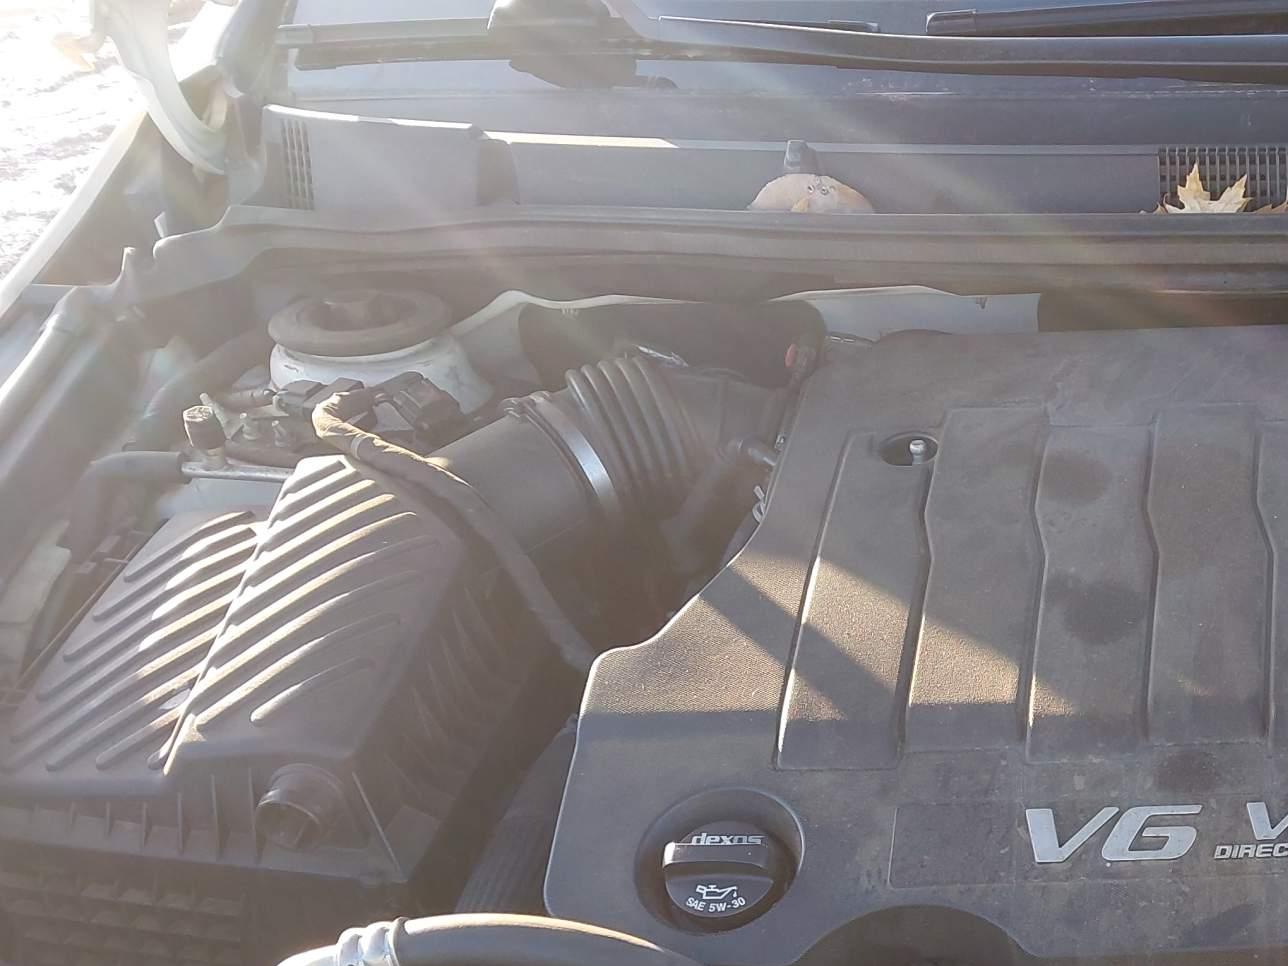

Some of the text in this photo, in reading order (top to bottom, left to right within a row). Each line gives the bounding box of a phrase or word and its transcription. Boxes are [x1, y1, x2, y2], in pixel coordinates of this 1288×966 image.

[691, 832, 766, 846] dexos
[1025, 804, 1203, 863] V6
[685, 896, 746, 913] SAE 5W-30
